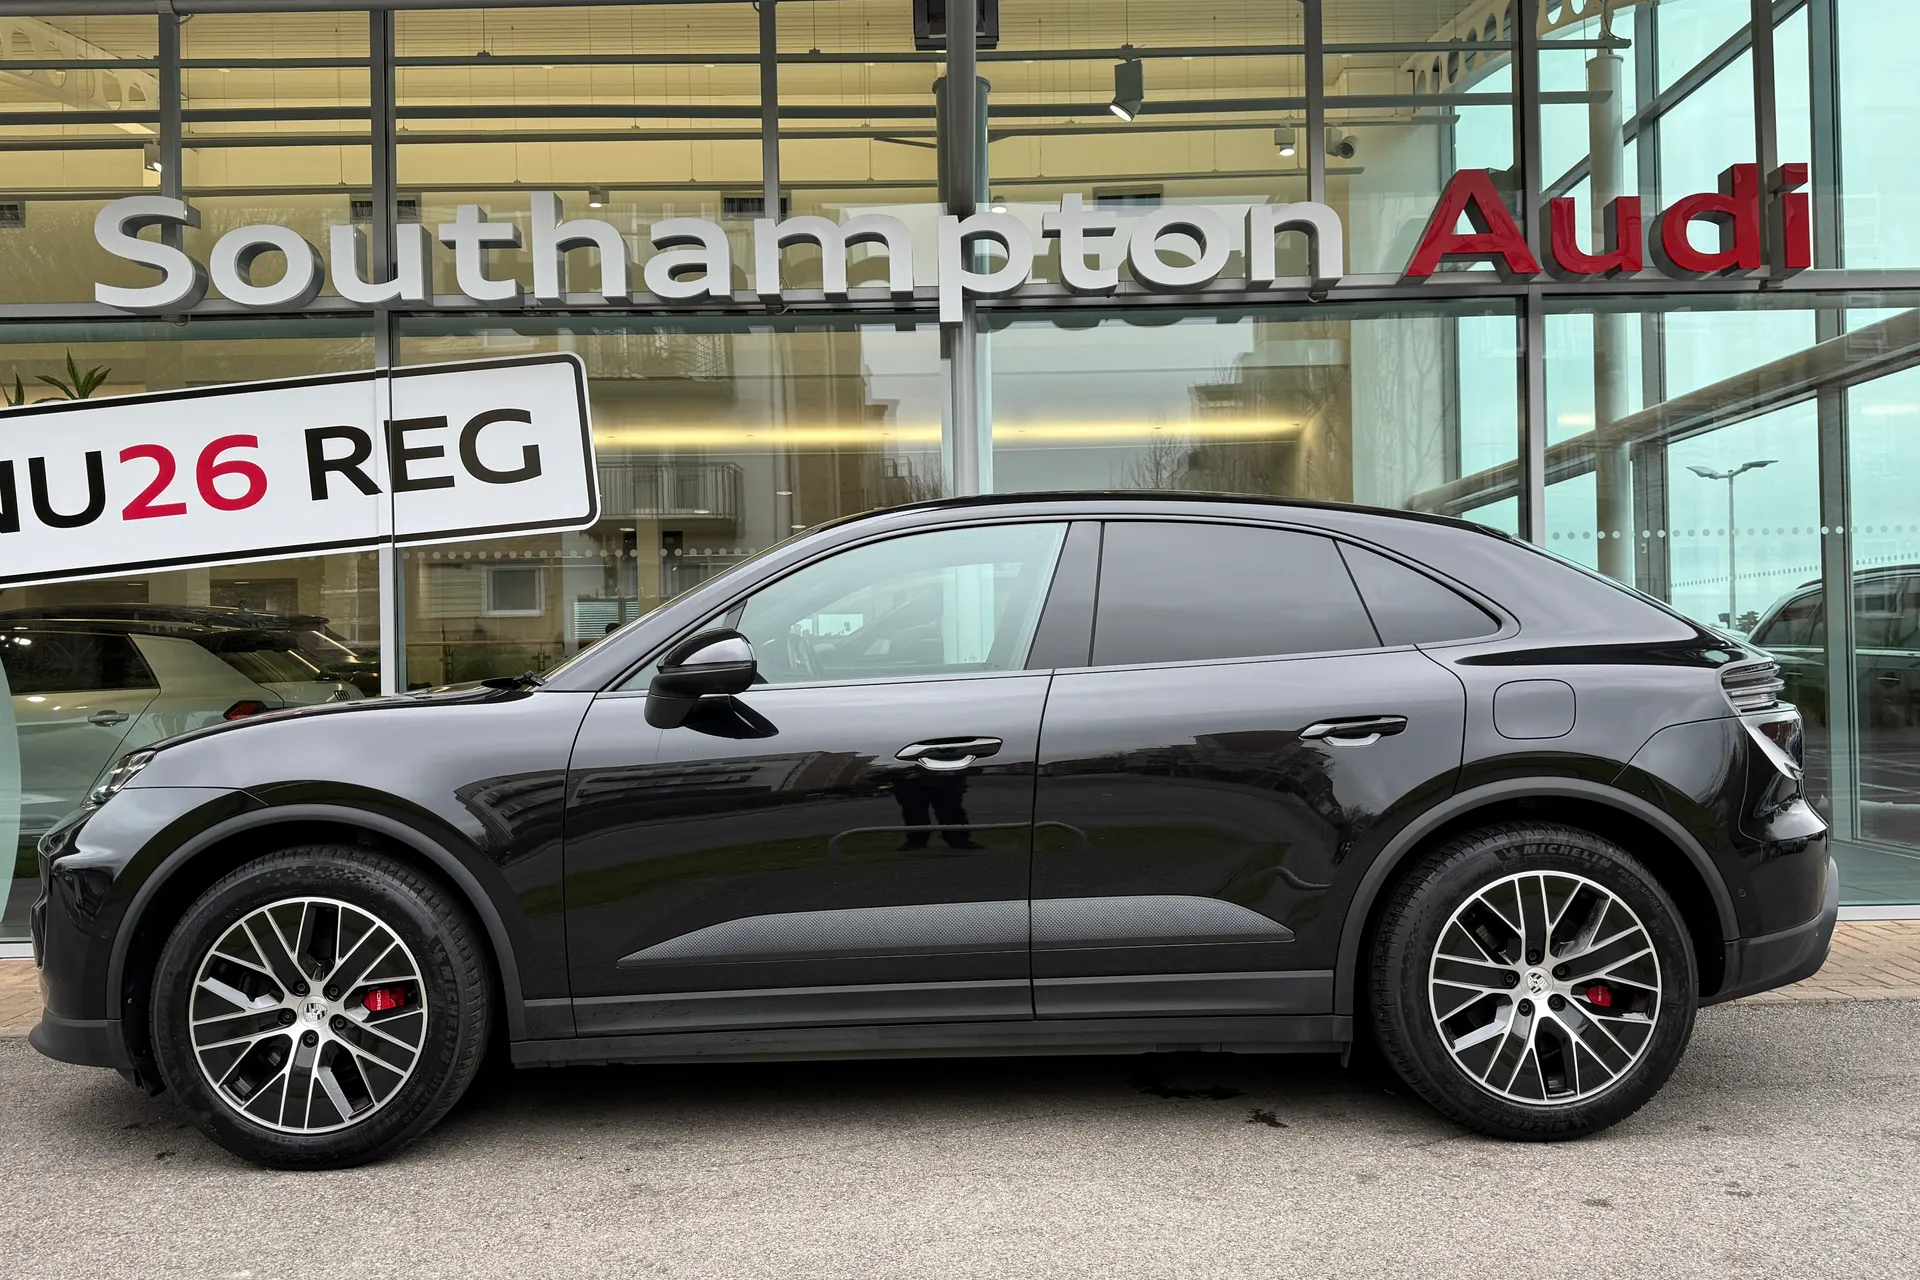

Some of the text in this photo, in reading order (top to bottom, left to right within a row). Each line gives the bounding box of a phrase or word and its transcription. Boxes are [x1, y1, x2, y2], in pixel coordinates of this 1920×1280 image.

[94, 162, 1812, 325] Southampton Audi
[0, 408, 542, 534] U26 REG
[1523, 843, 1614, 868] MICHELIN
[440, 965, 458, 1064] MICHELIN
